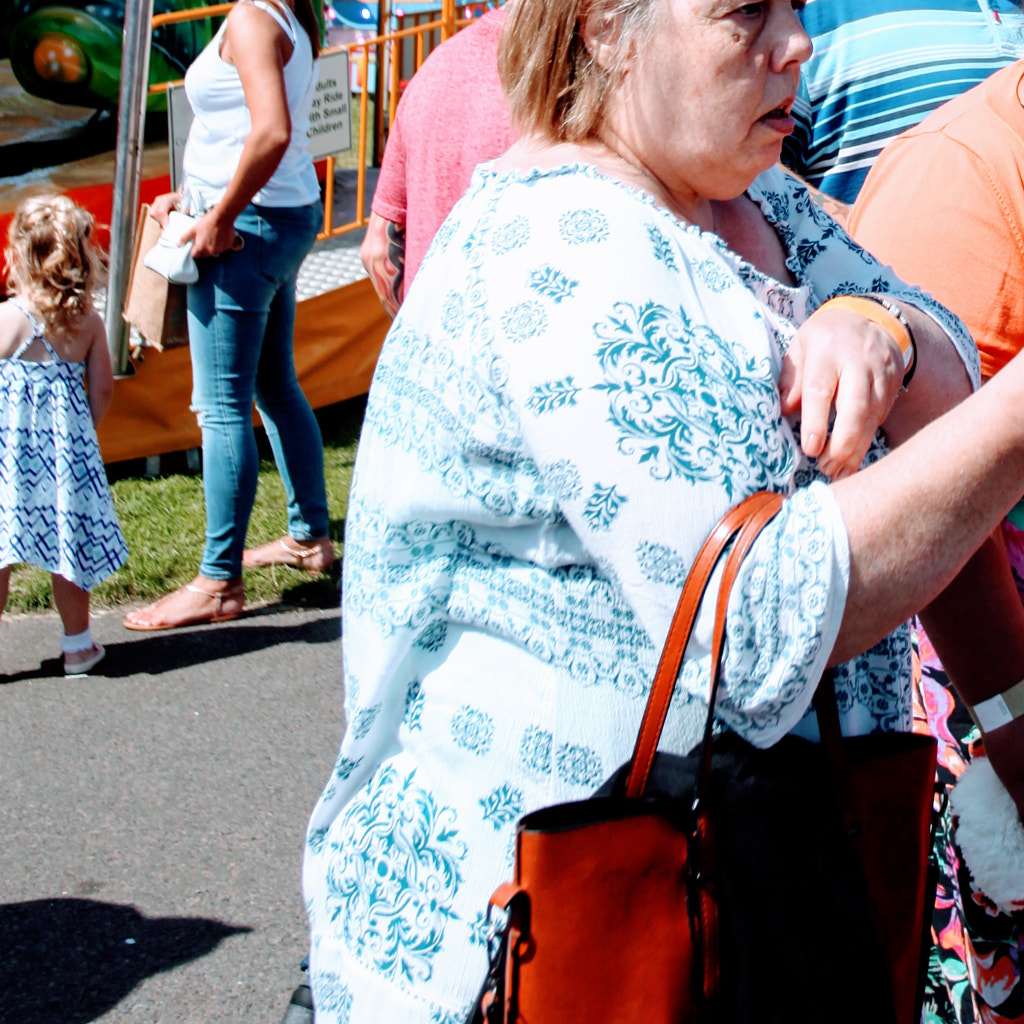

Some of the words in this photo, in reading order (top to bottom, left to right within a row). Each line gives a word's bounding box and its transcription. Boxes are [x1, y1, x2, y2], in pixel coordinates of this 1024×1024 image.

[315, 78, 337, 92] dults
[323, 91, 343, 104] Ride
[322, 102, 347, 119] Small
